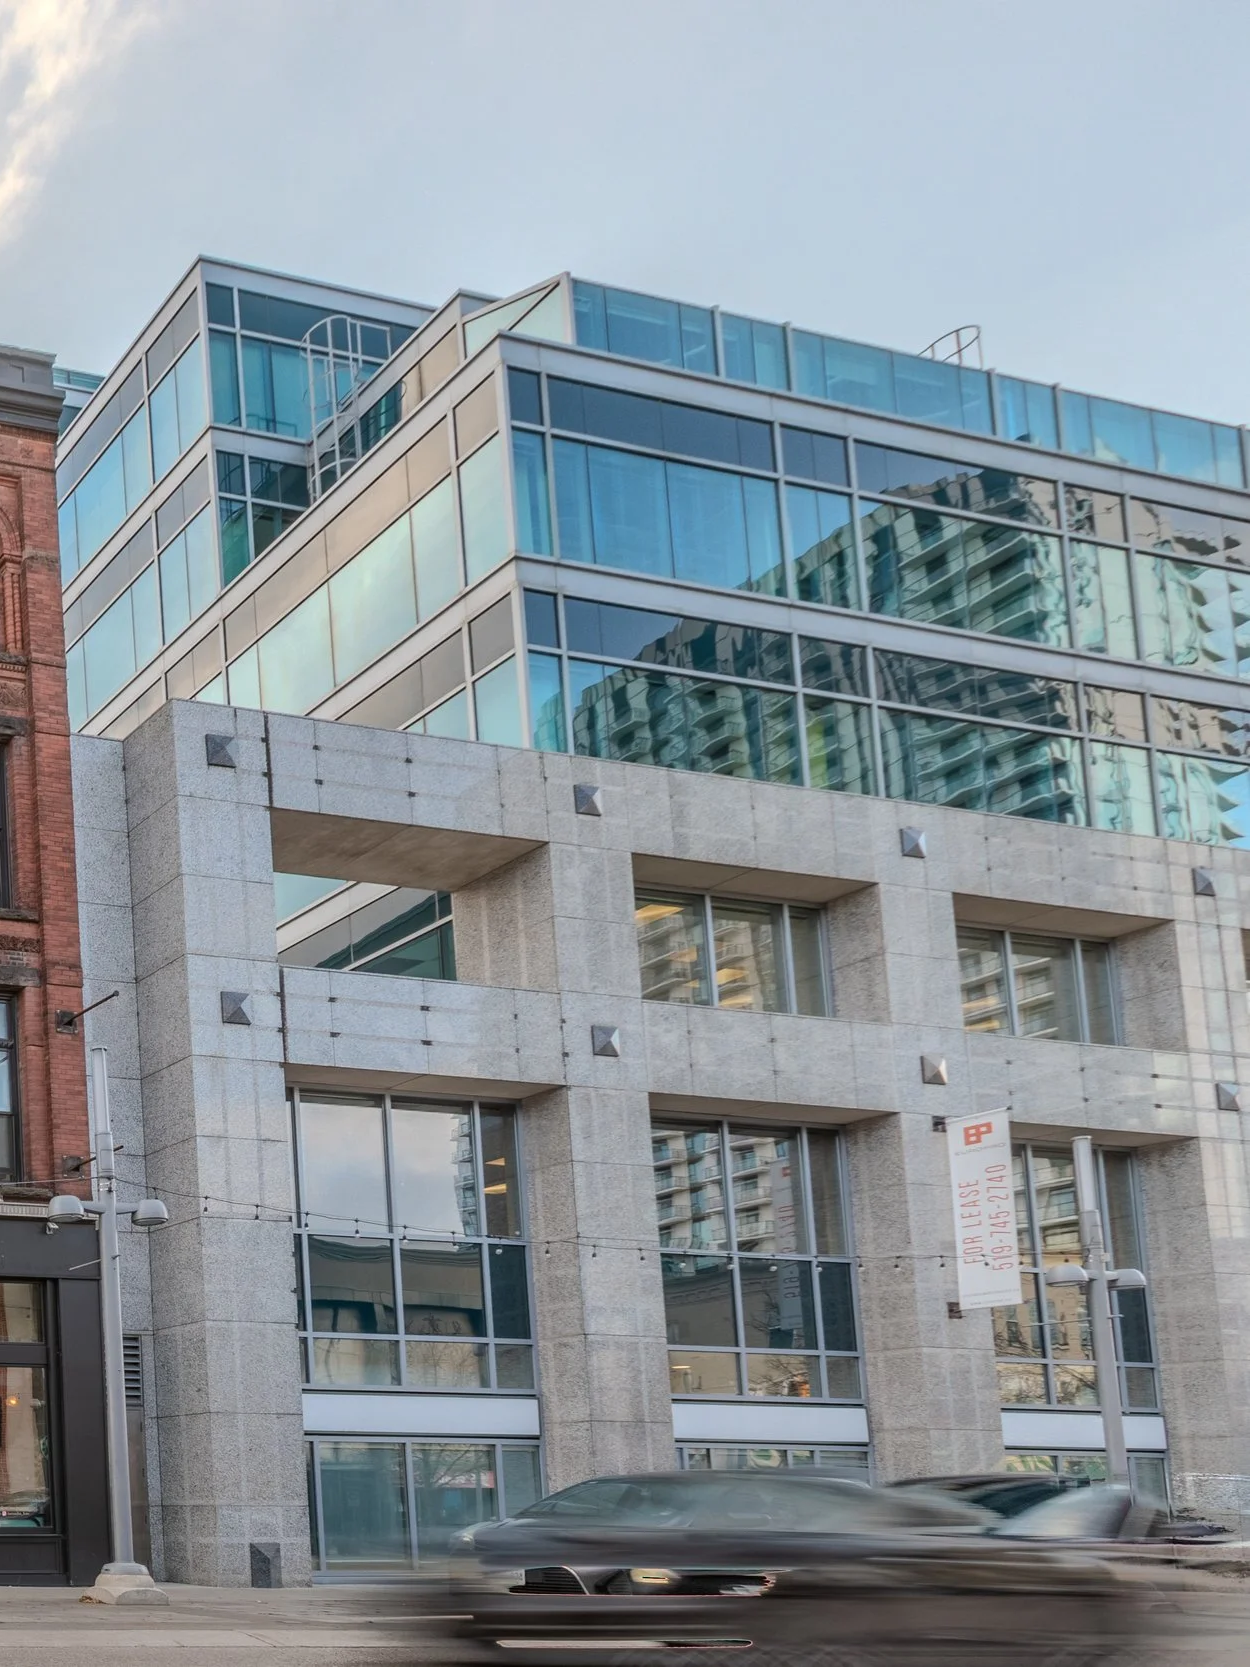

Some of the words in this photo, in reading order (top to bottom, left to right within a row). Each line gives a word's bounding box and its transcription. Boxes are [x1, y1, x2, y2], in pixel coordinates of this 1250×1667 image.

[958, 1179, 982, 1229] LEASE
[984, 1164, 1014, 1271] 519-745-2740
[962, 1235, 985, 1265] FOR
